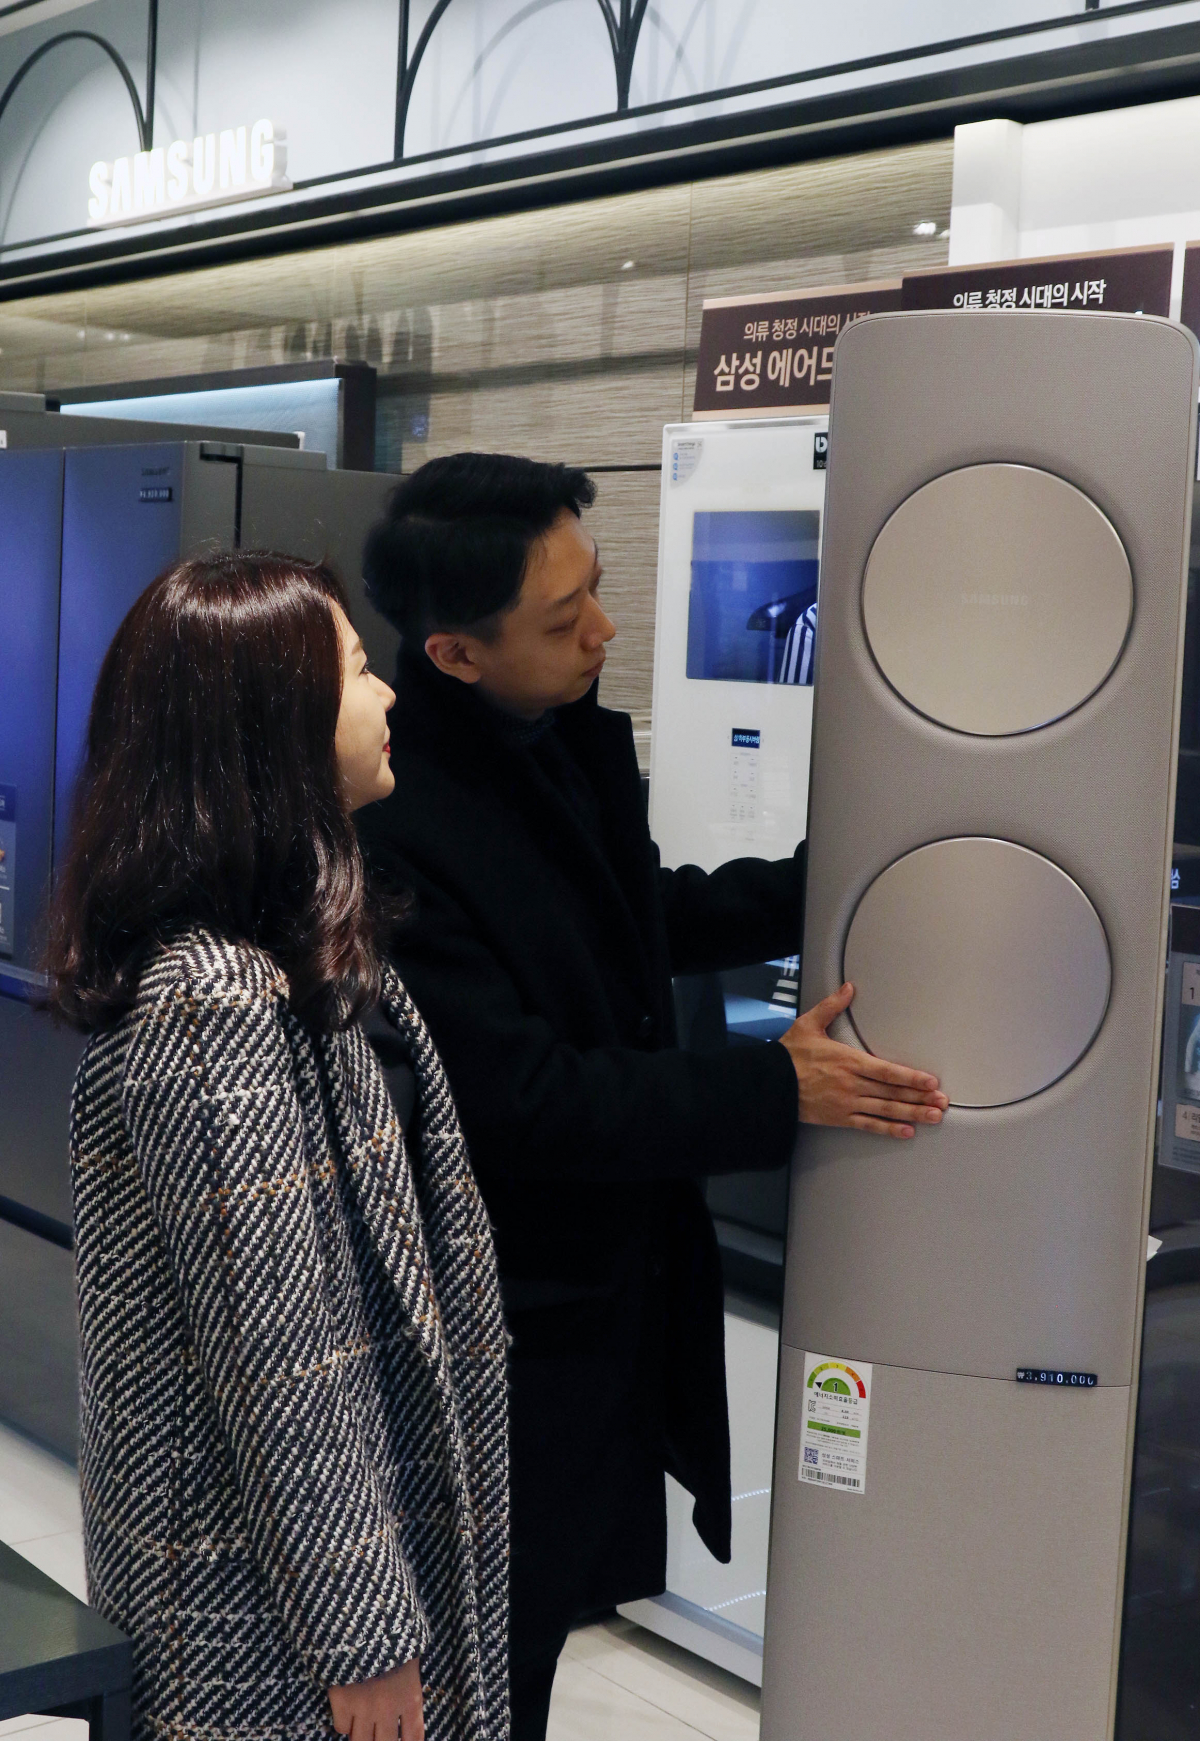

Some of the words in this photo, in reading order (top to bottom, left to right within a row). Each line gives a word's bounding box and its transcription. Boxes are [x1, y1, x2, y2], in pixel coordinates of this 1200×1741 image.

[87, 118, 275, 220] SAMSUNG
[1019, 282, 1069, 309] 시대의
[1070, 279, 1107, 305] 시작
[743, 320, 770, 342] 의류
[771, 317, 799, 341] 청정
[799, 313, 841, 337] 시대의
[713, 350, 763, 392] 삼성
[833, 1382, 838, 1392] 1
